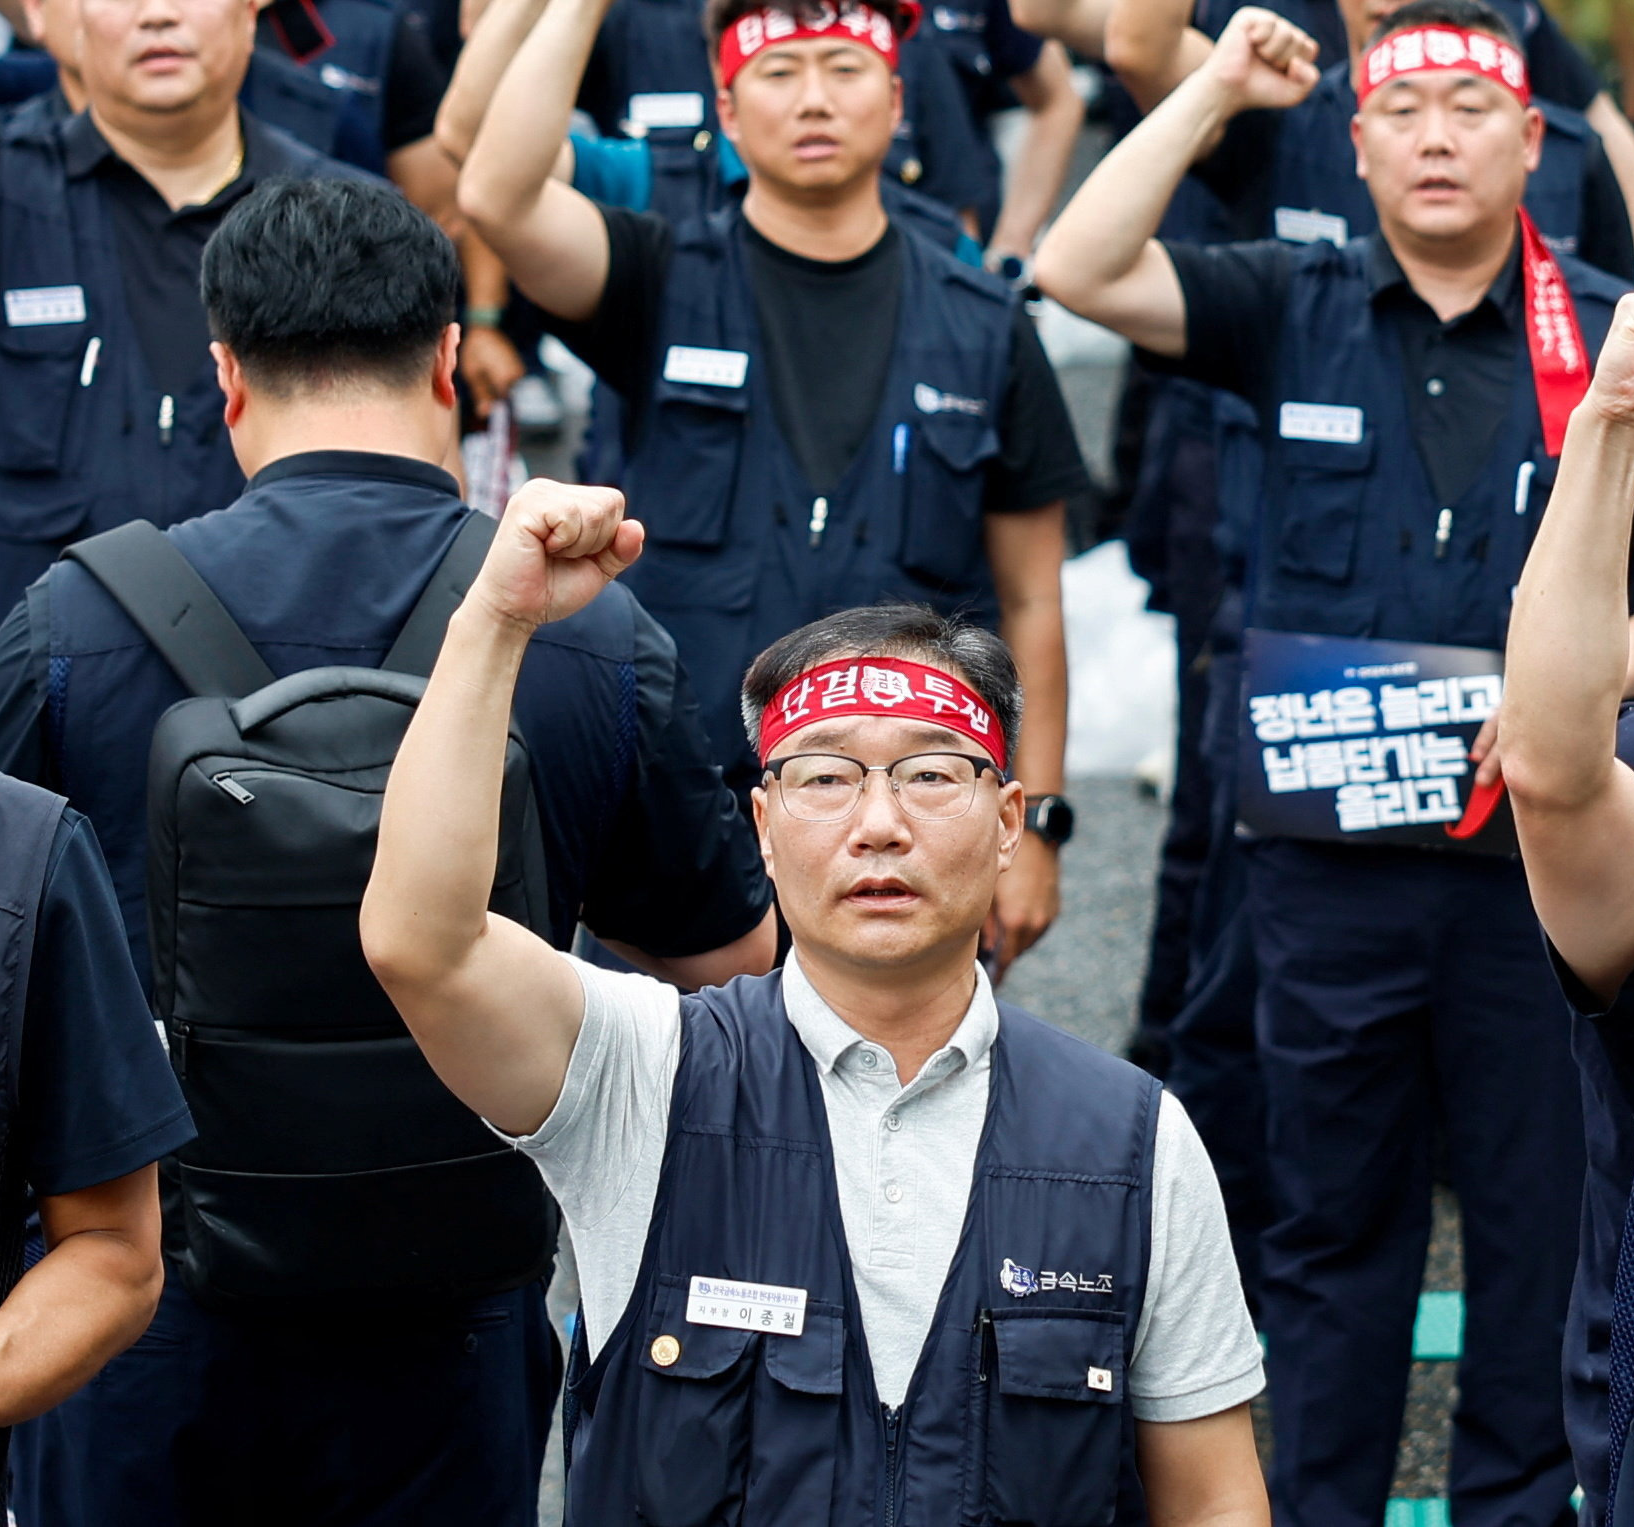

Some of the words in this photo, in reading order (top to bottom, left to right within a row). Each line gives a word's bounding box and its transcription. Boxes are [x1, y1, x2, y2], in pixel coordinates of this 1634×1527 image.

[1368, 29, 1425, 86] 단결
[1468, 33, 1525, 89] 투쟁
[781, 665, 859, 725] 단결
[915, 673, 990, 735] 투쟁
[1249, 686, 1377, 743] 정년은
[1379, 674, 1504, 731] 늘리고
[1262, 731, 1468, 794] 납품단가는
[1335, 776, 1463, 833] 올리고
[1039, 1270, 1113, 1293] 금속노조
